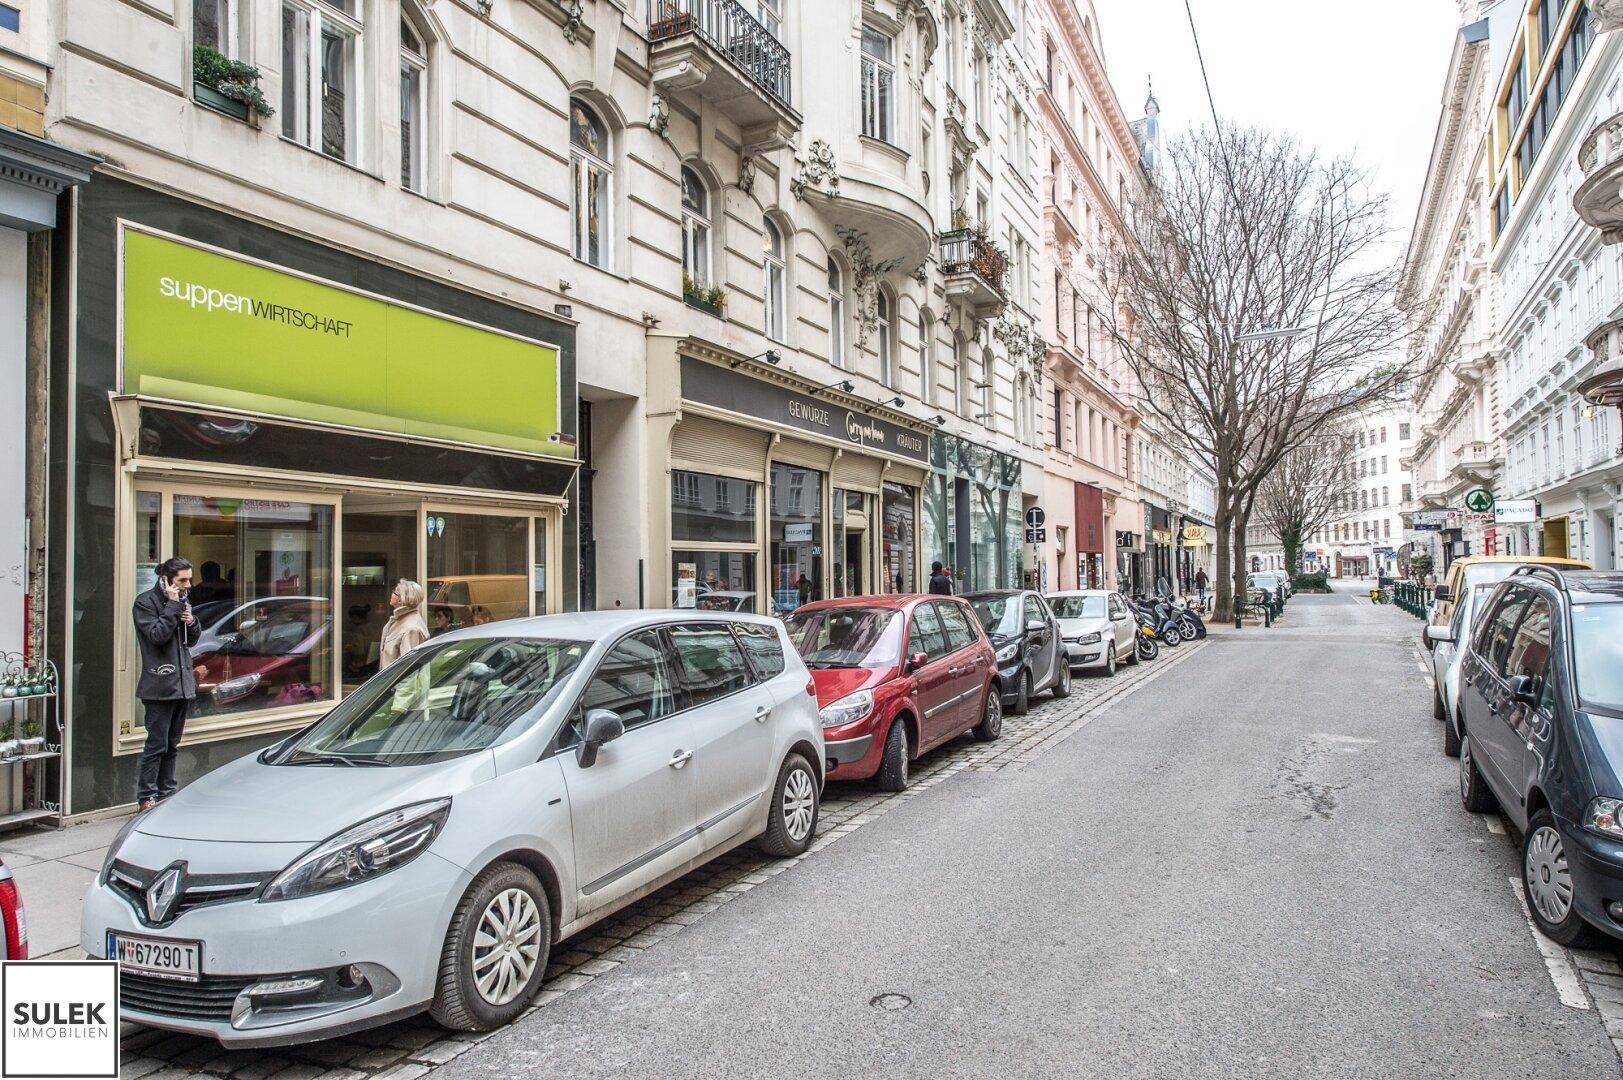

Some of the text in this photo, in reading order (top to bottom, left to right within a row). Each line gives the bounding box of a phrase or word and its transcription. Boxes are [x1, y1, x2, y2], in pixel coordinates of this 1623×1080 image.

[789, 400, 830, 427] GEWÜRZE
[897, 433, 922, 452] KRÄUTER
[117, 939, 194, 970] W 67290 T
